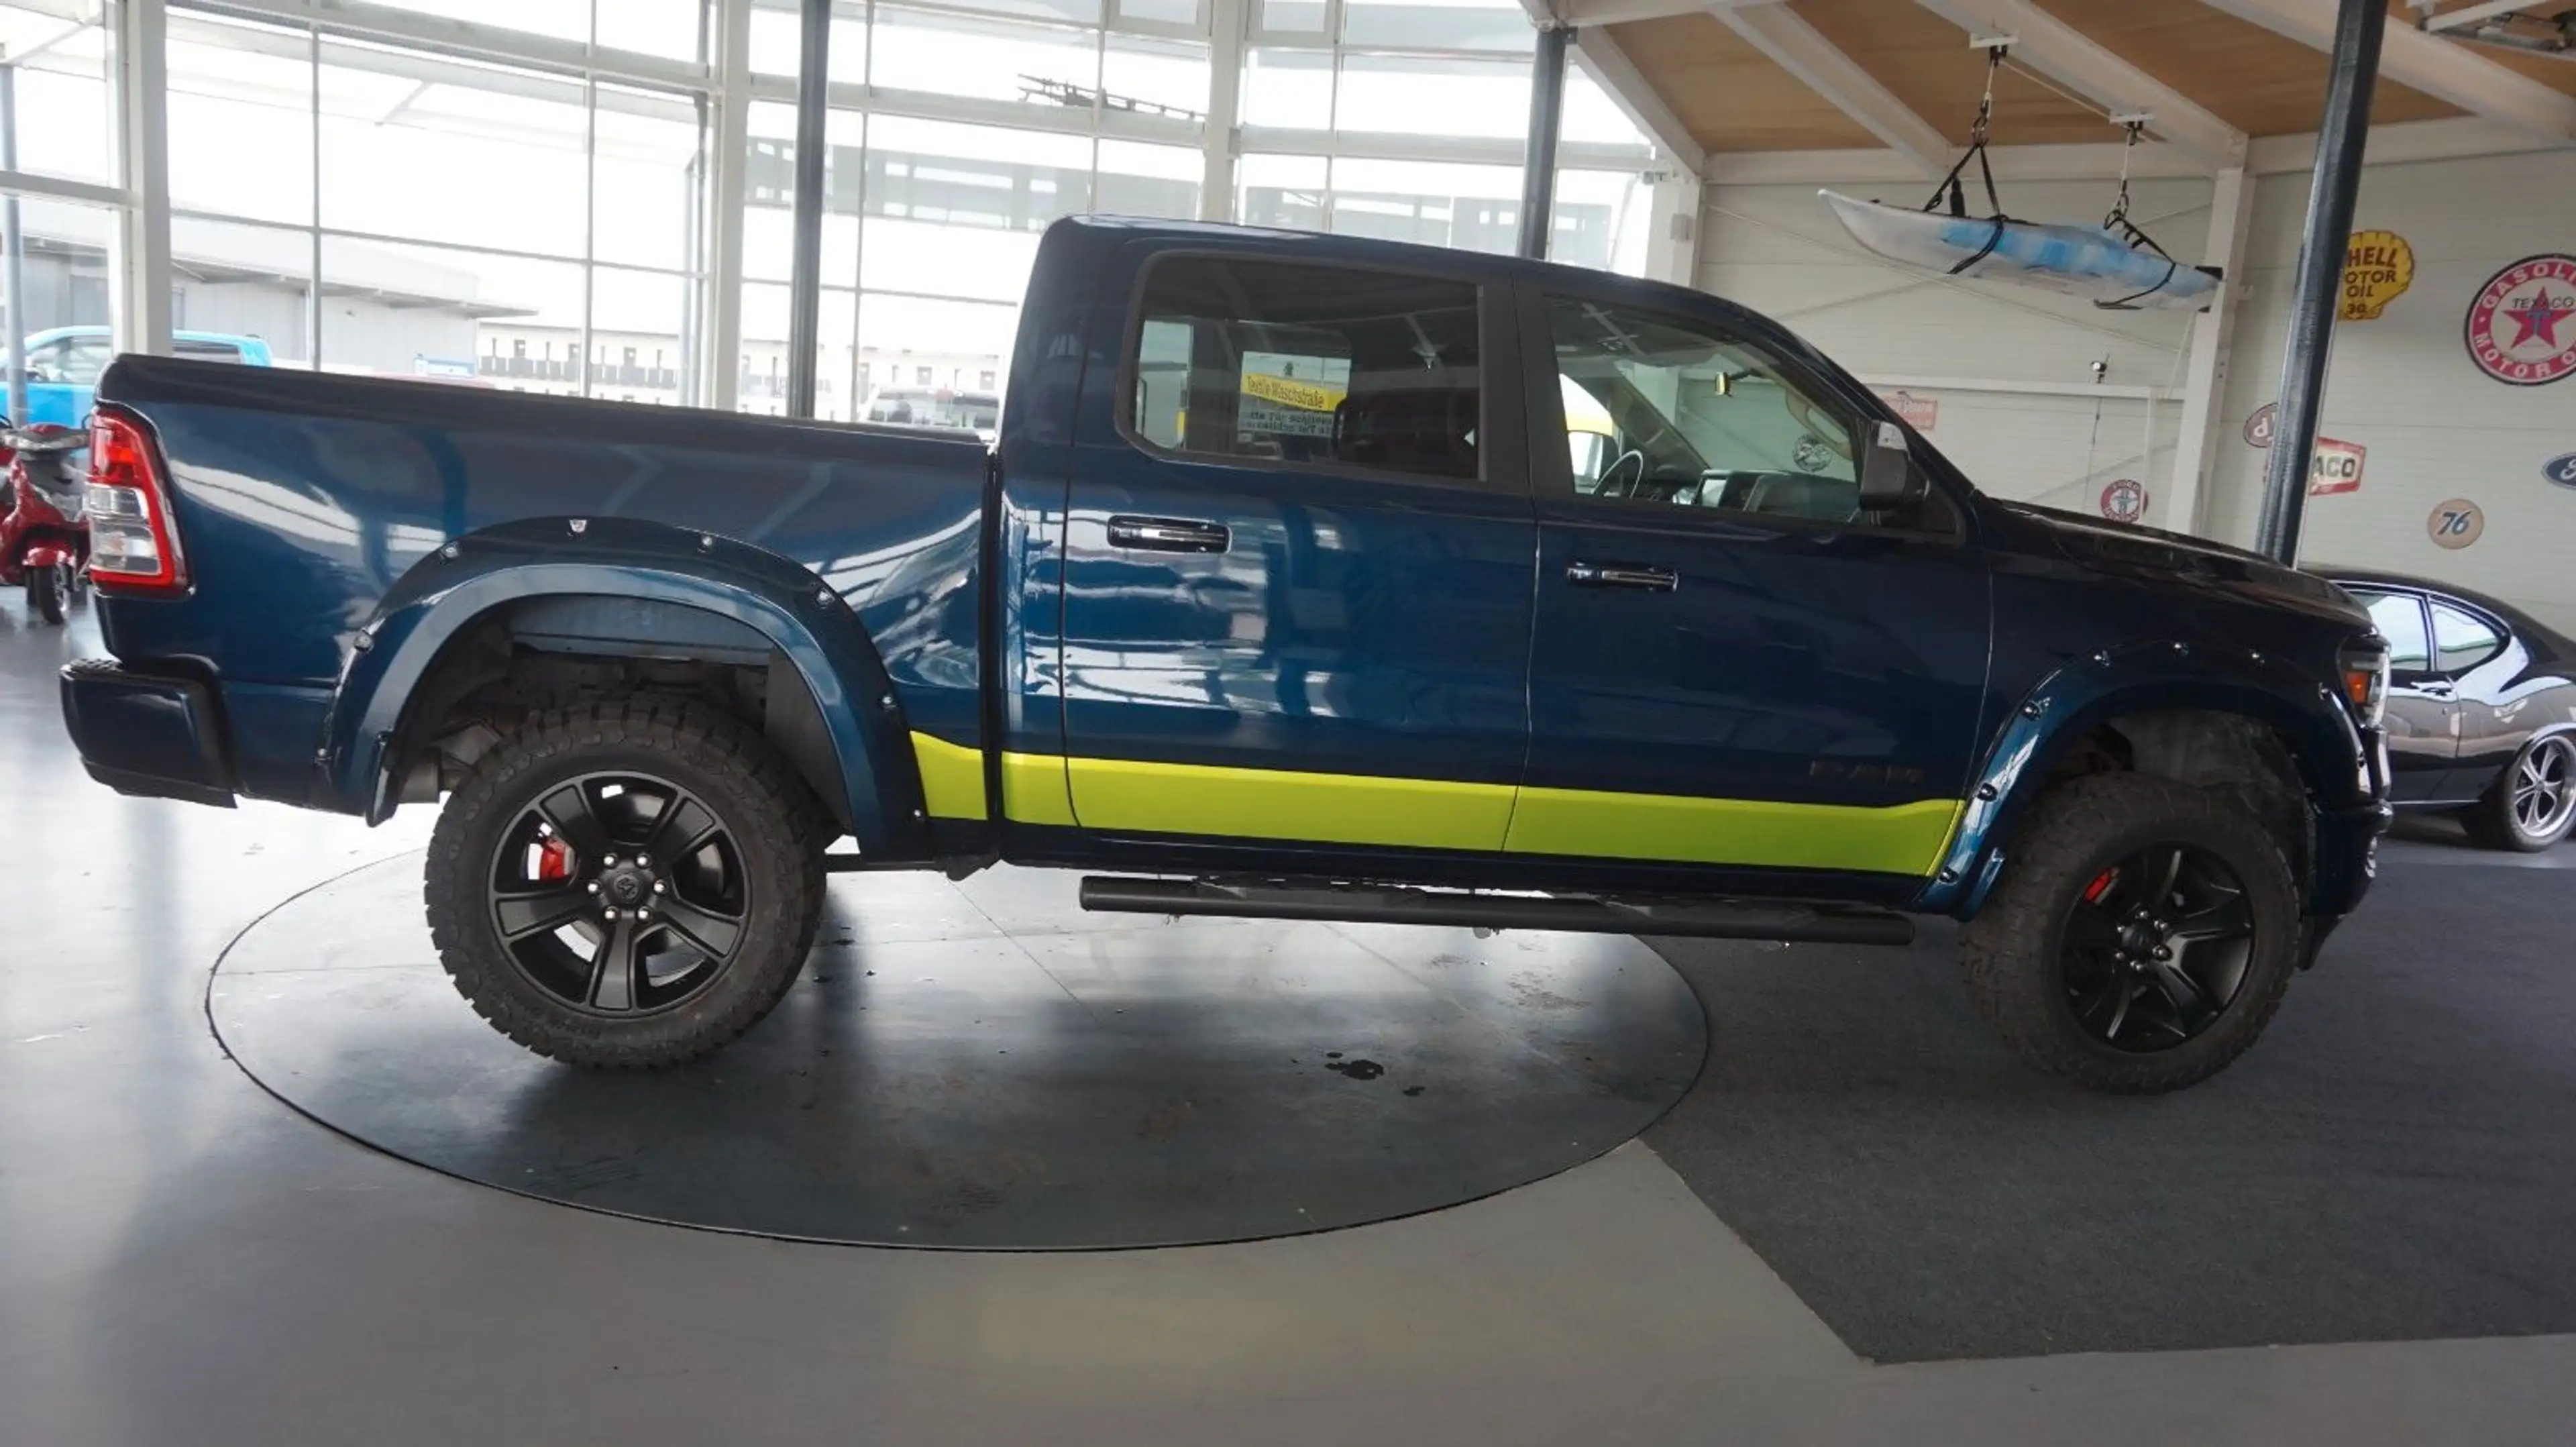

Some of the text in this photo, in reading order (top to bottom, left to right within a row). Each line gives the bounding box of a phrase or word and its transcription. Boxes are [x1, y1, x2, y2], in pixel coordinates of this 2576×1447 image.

[2349, 246, 2398, 268] HELL
[2346, 270, 2397, 283] OTOR
[2483, 263, 2576, 309] GASOLI
[2347, 284, 2374, 297] OIL
[2512, 297, 2575, 309] TEXACO
[2475, 333, 2551, 377] MOTOR
[2313, 455, 2356, 478] ACO
[2437, 511, 2472, 536] 76
